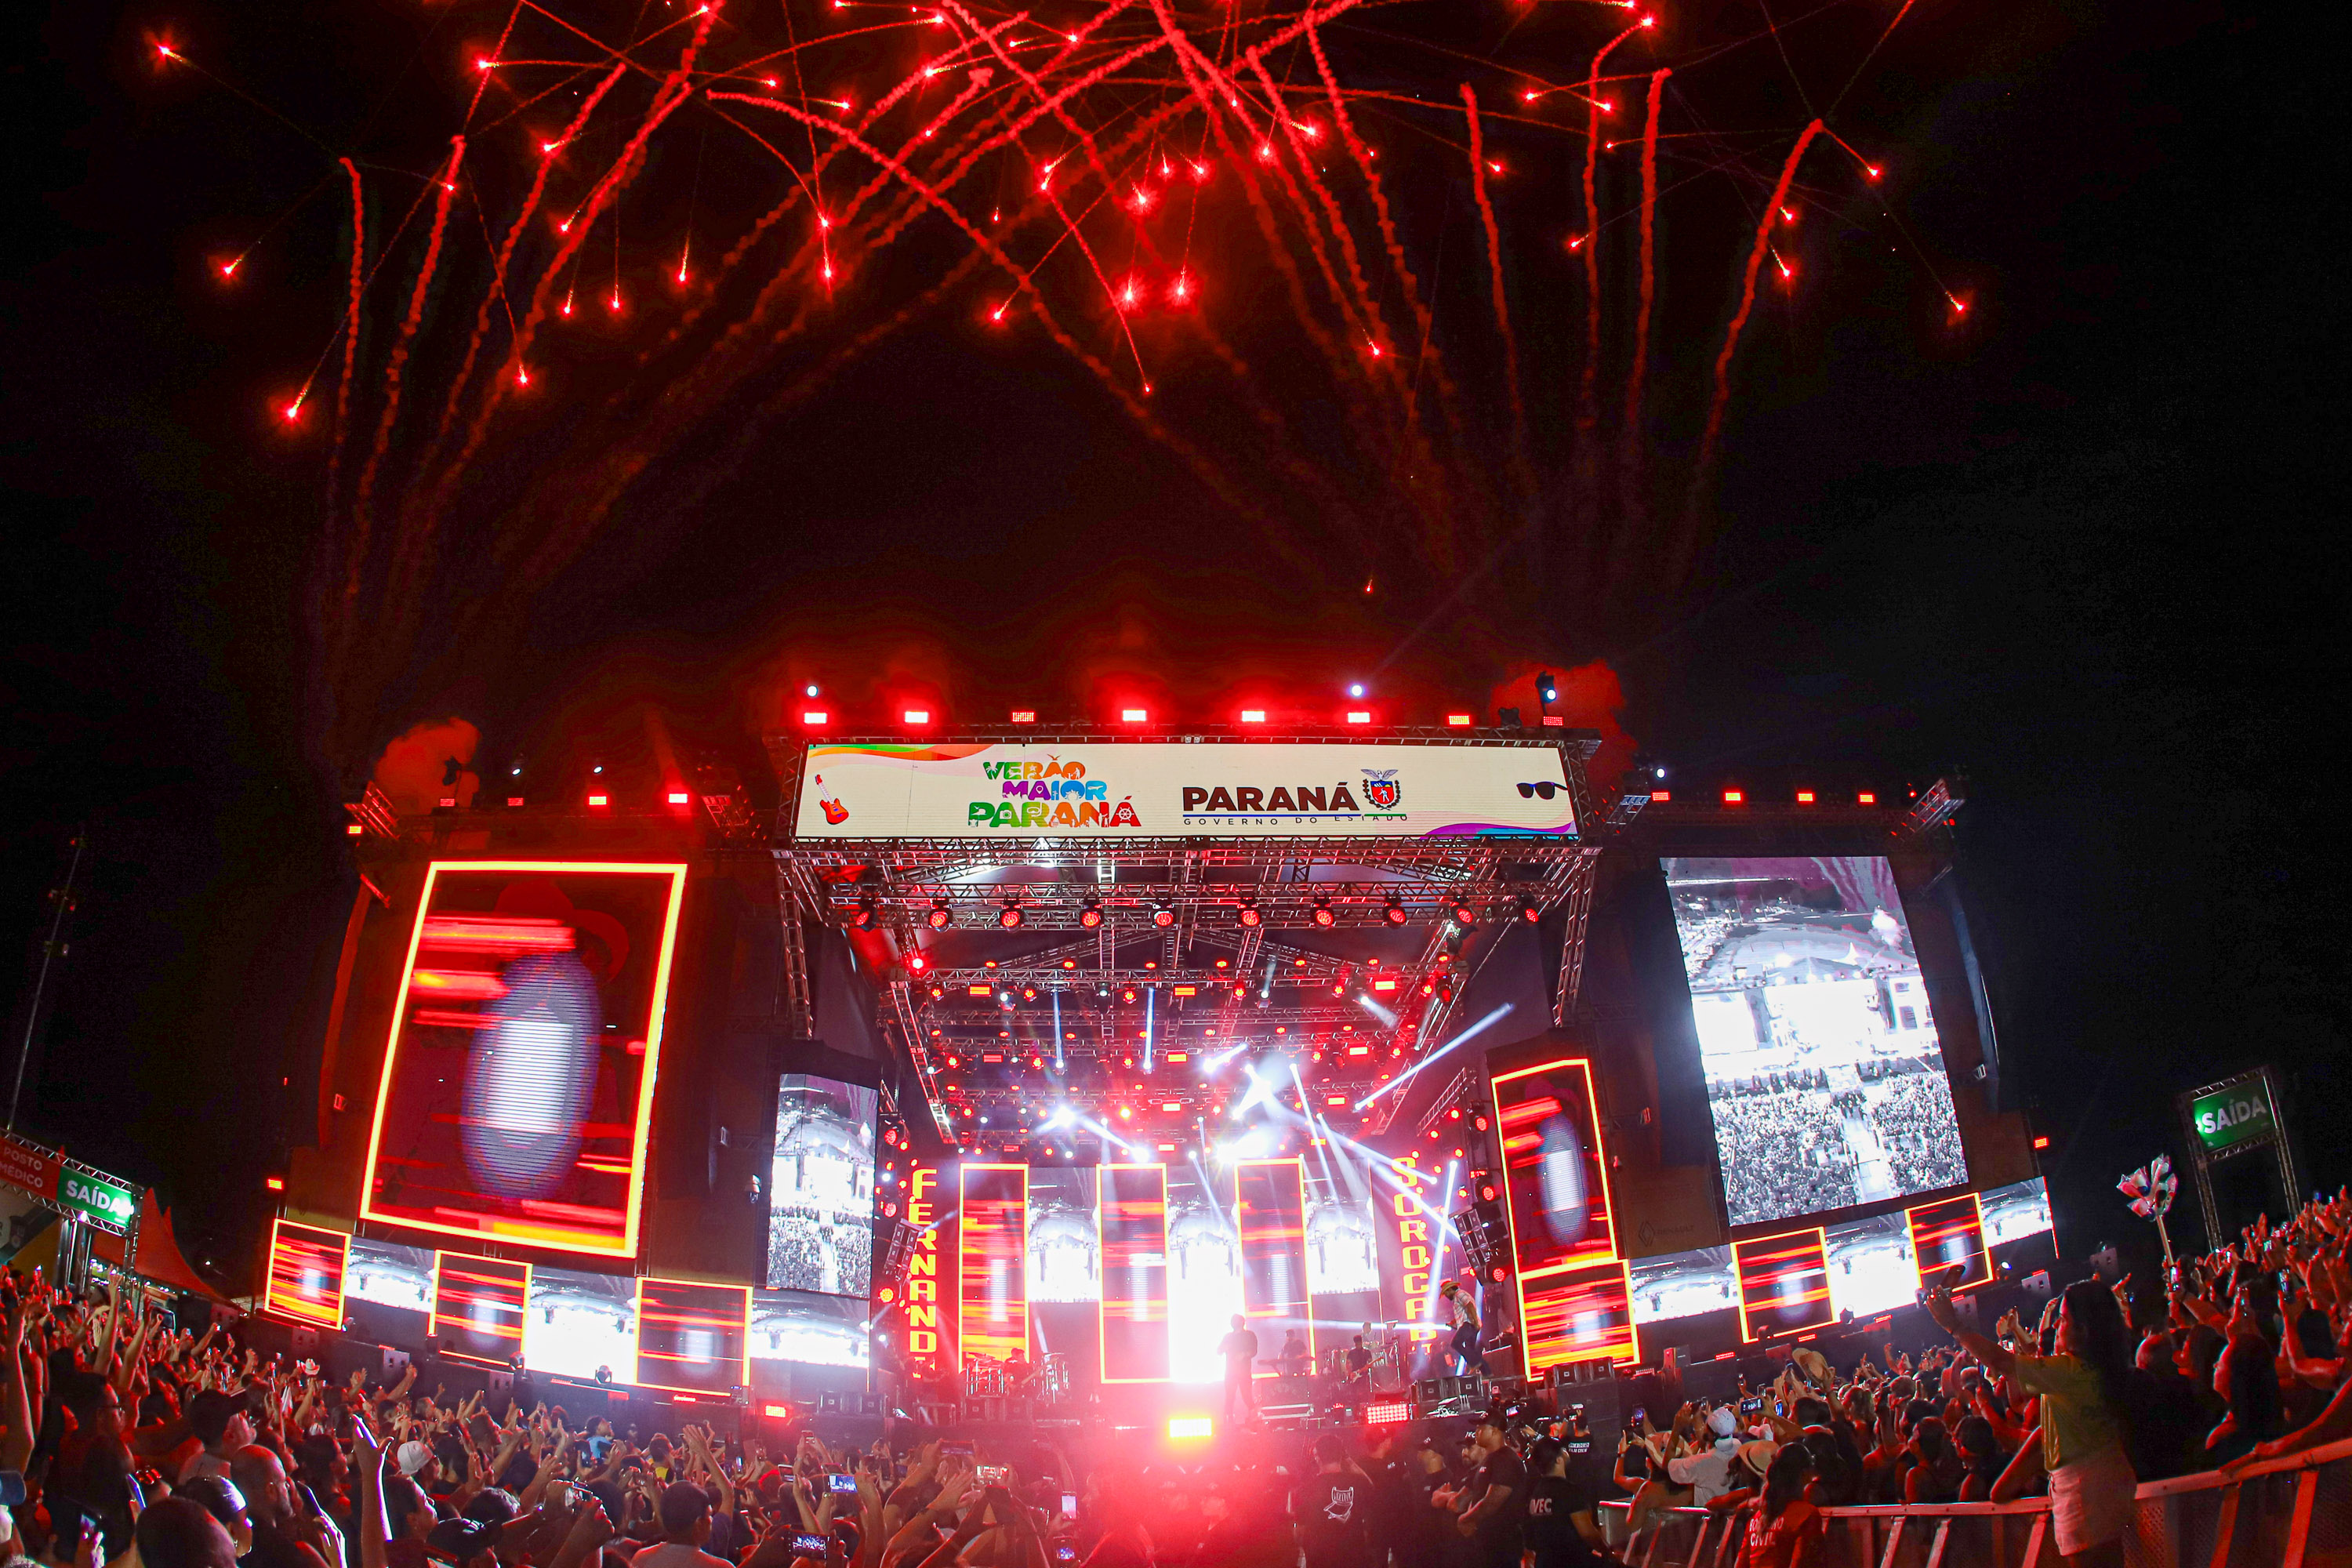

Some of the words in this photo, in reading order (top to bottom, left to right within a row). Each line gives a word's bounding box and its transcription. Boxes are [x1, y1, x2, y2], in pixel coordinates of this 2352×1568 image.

[1002, 780, 1108, 800] MAIOR
[1182, 782, 1360, 811] PARANÁ
[968, 796, 1142, 828] PARANÁ
[2201, 1095, 2267, 1134] SAÍDA
[4, 1146, 43, 1171] POSTO
